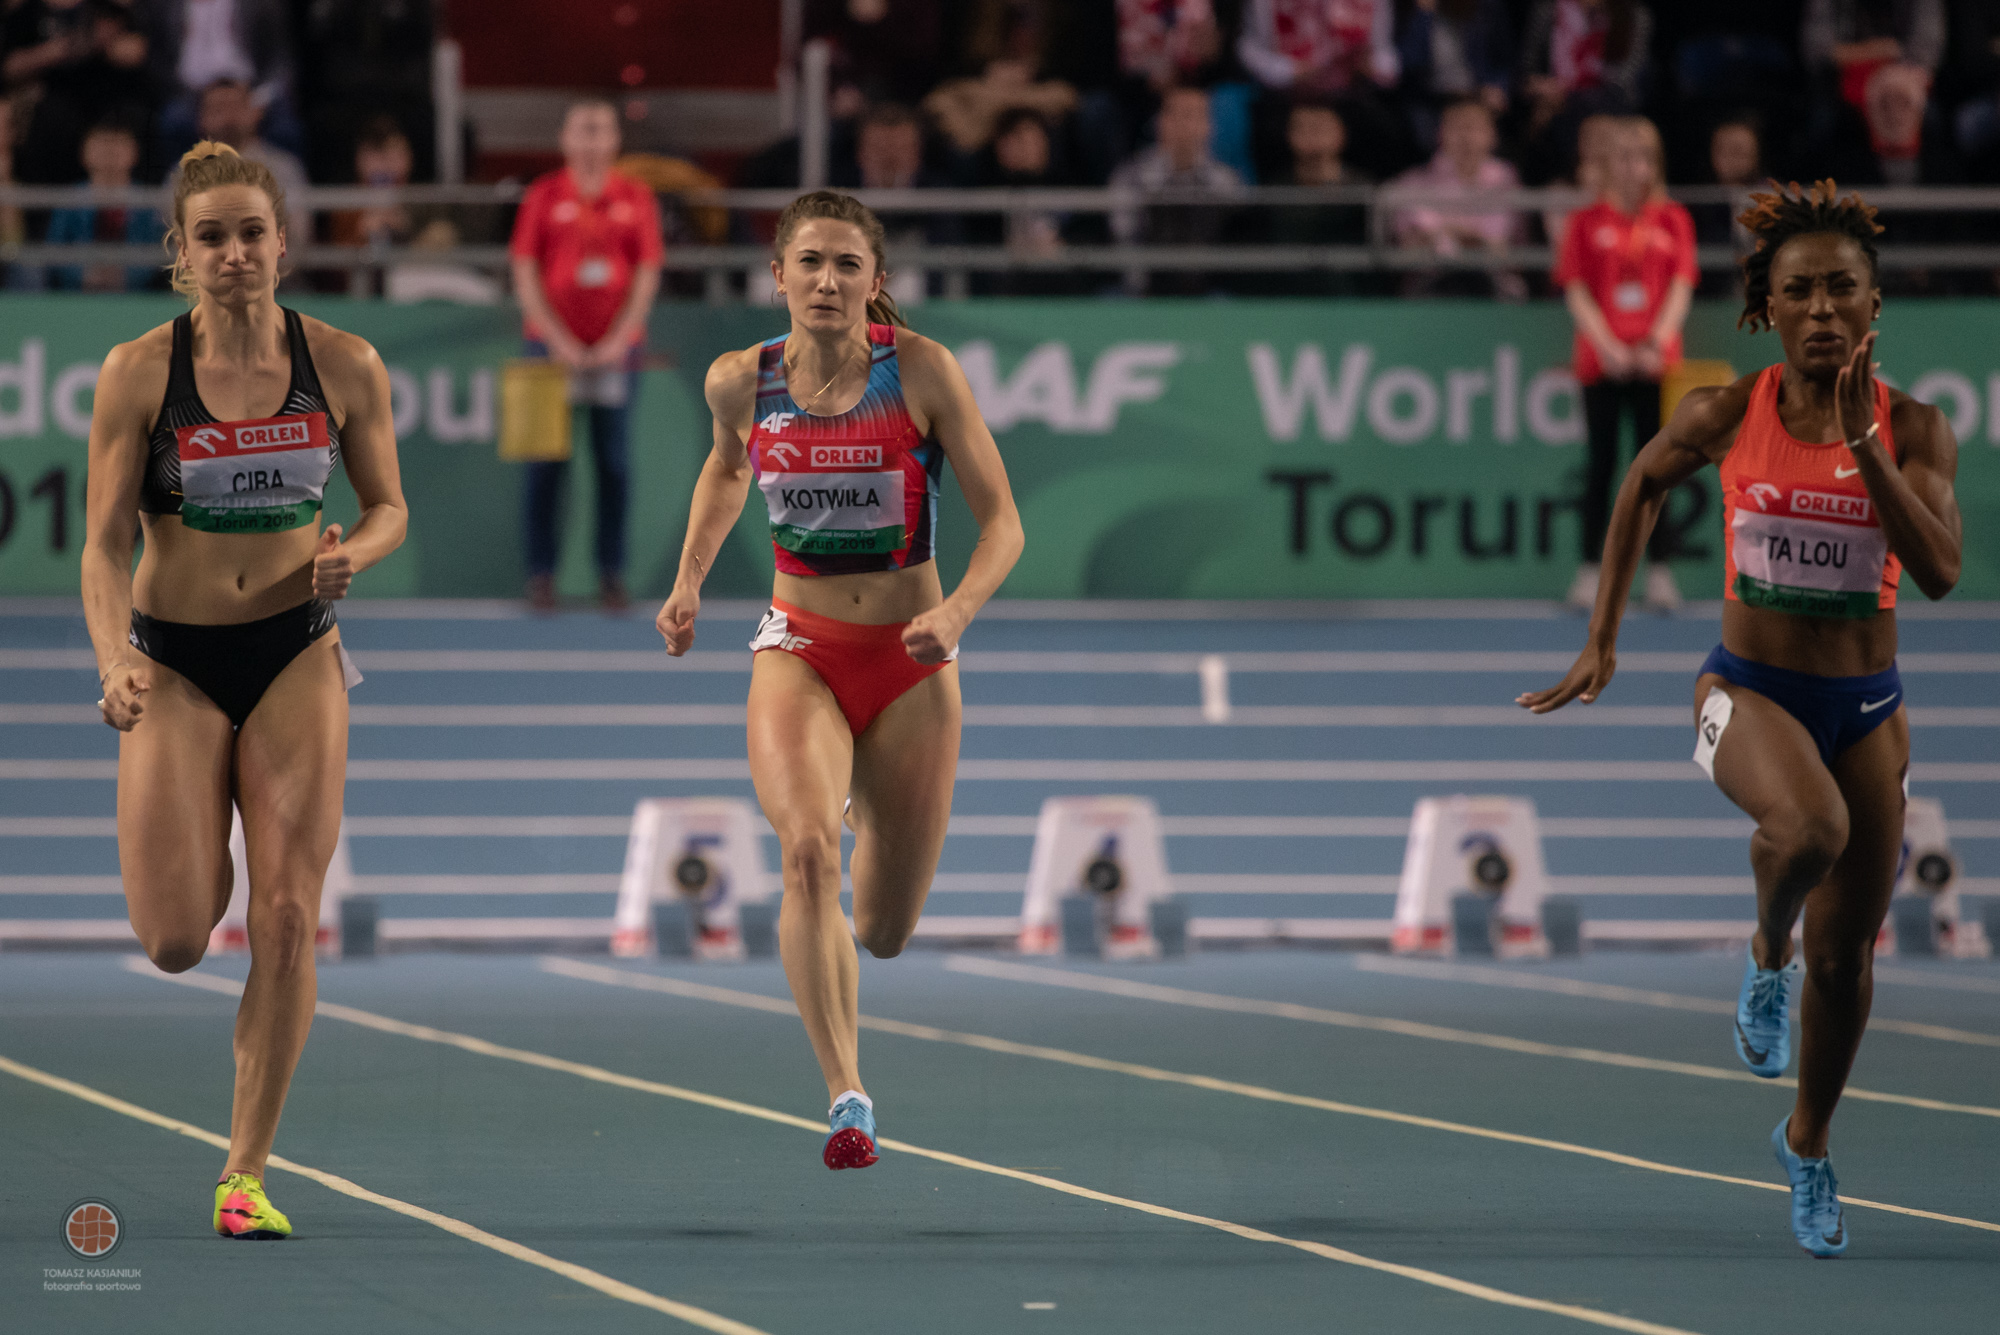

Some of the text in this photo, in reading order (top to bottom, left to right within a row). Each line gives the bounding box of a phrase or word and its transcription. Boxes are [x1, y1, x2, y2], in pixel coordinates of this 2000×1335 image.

[759, 411, 795, 434] 4F
[240, 426, 304, 445] ORLEN
[814, 449, 878, 464] ORLEN
[232, 469, 285, 493] CIBA
[781, 488, 880, 510] KOTWIŁA
[1796, 494, 1864, 517] ORLEN
[263, 512, 296, 528] 2019
[839, 538, 875, 549] 2019
[1767, 536, 1848, 569] TA LOU
